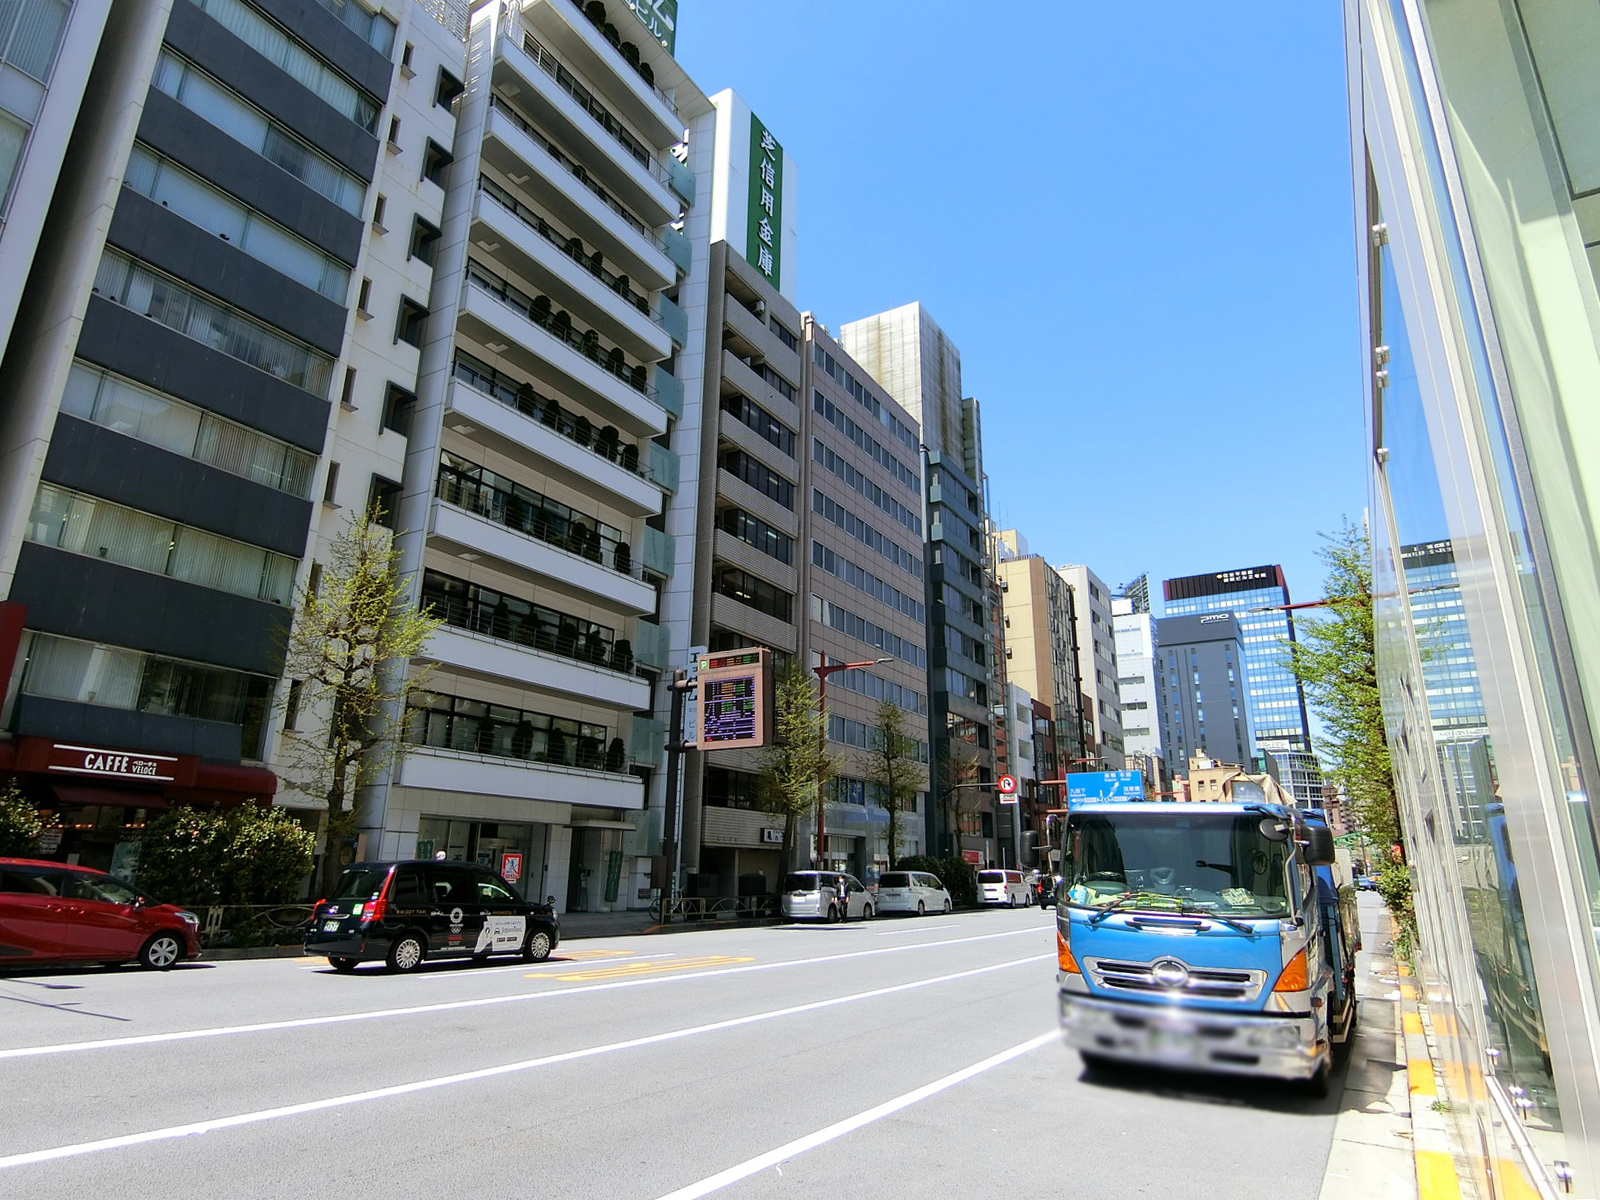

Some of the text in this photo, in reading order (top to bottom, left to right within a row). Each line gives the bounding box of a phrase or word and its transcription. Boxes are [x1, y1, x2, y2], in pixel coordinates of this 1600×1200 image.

[757, 128, 776, 278] 芝信用金庫
[700, 660, 707, 670] P
[132, 765, 157, 776] VELOCE
